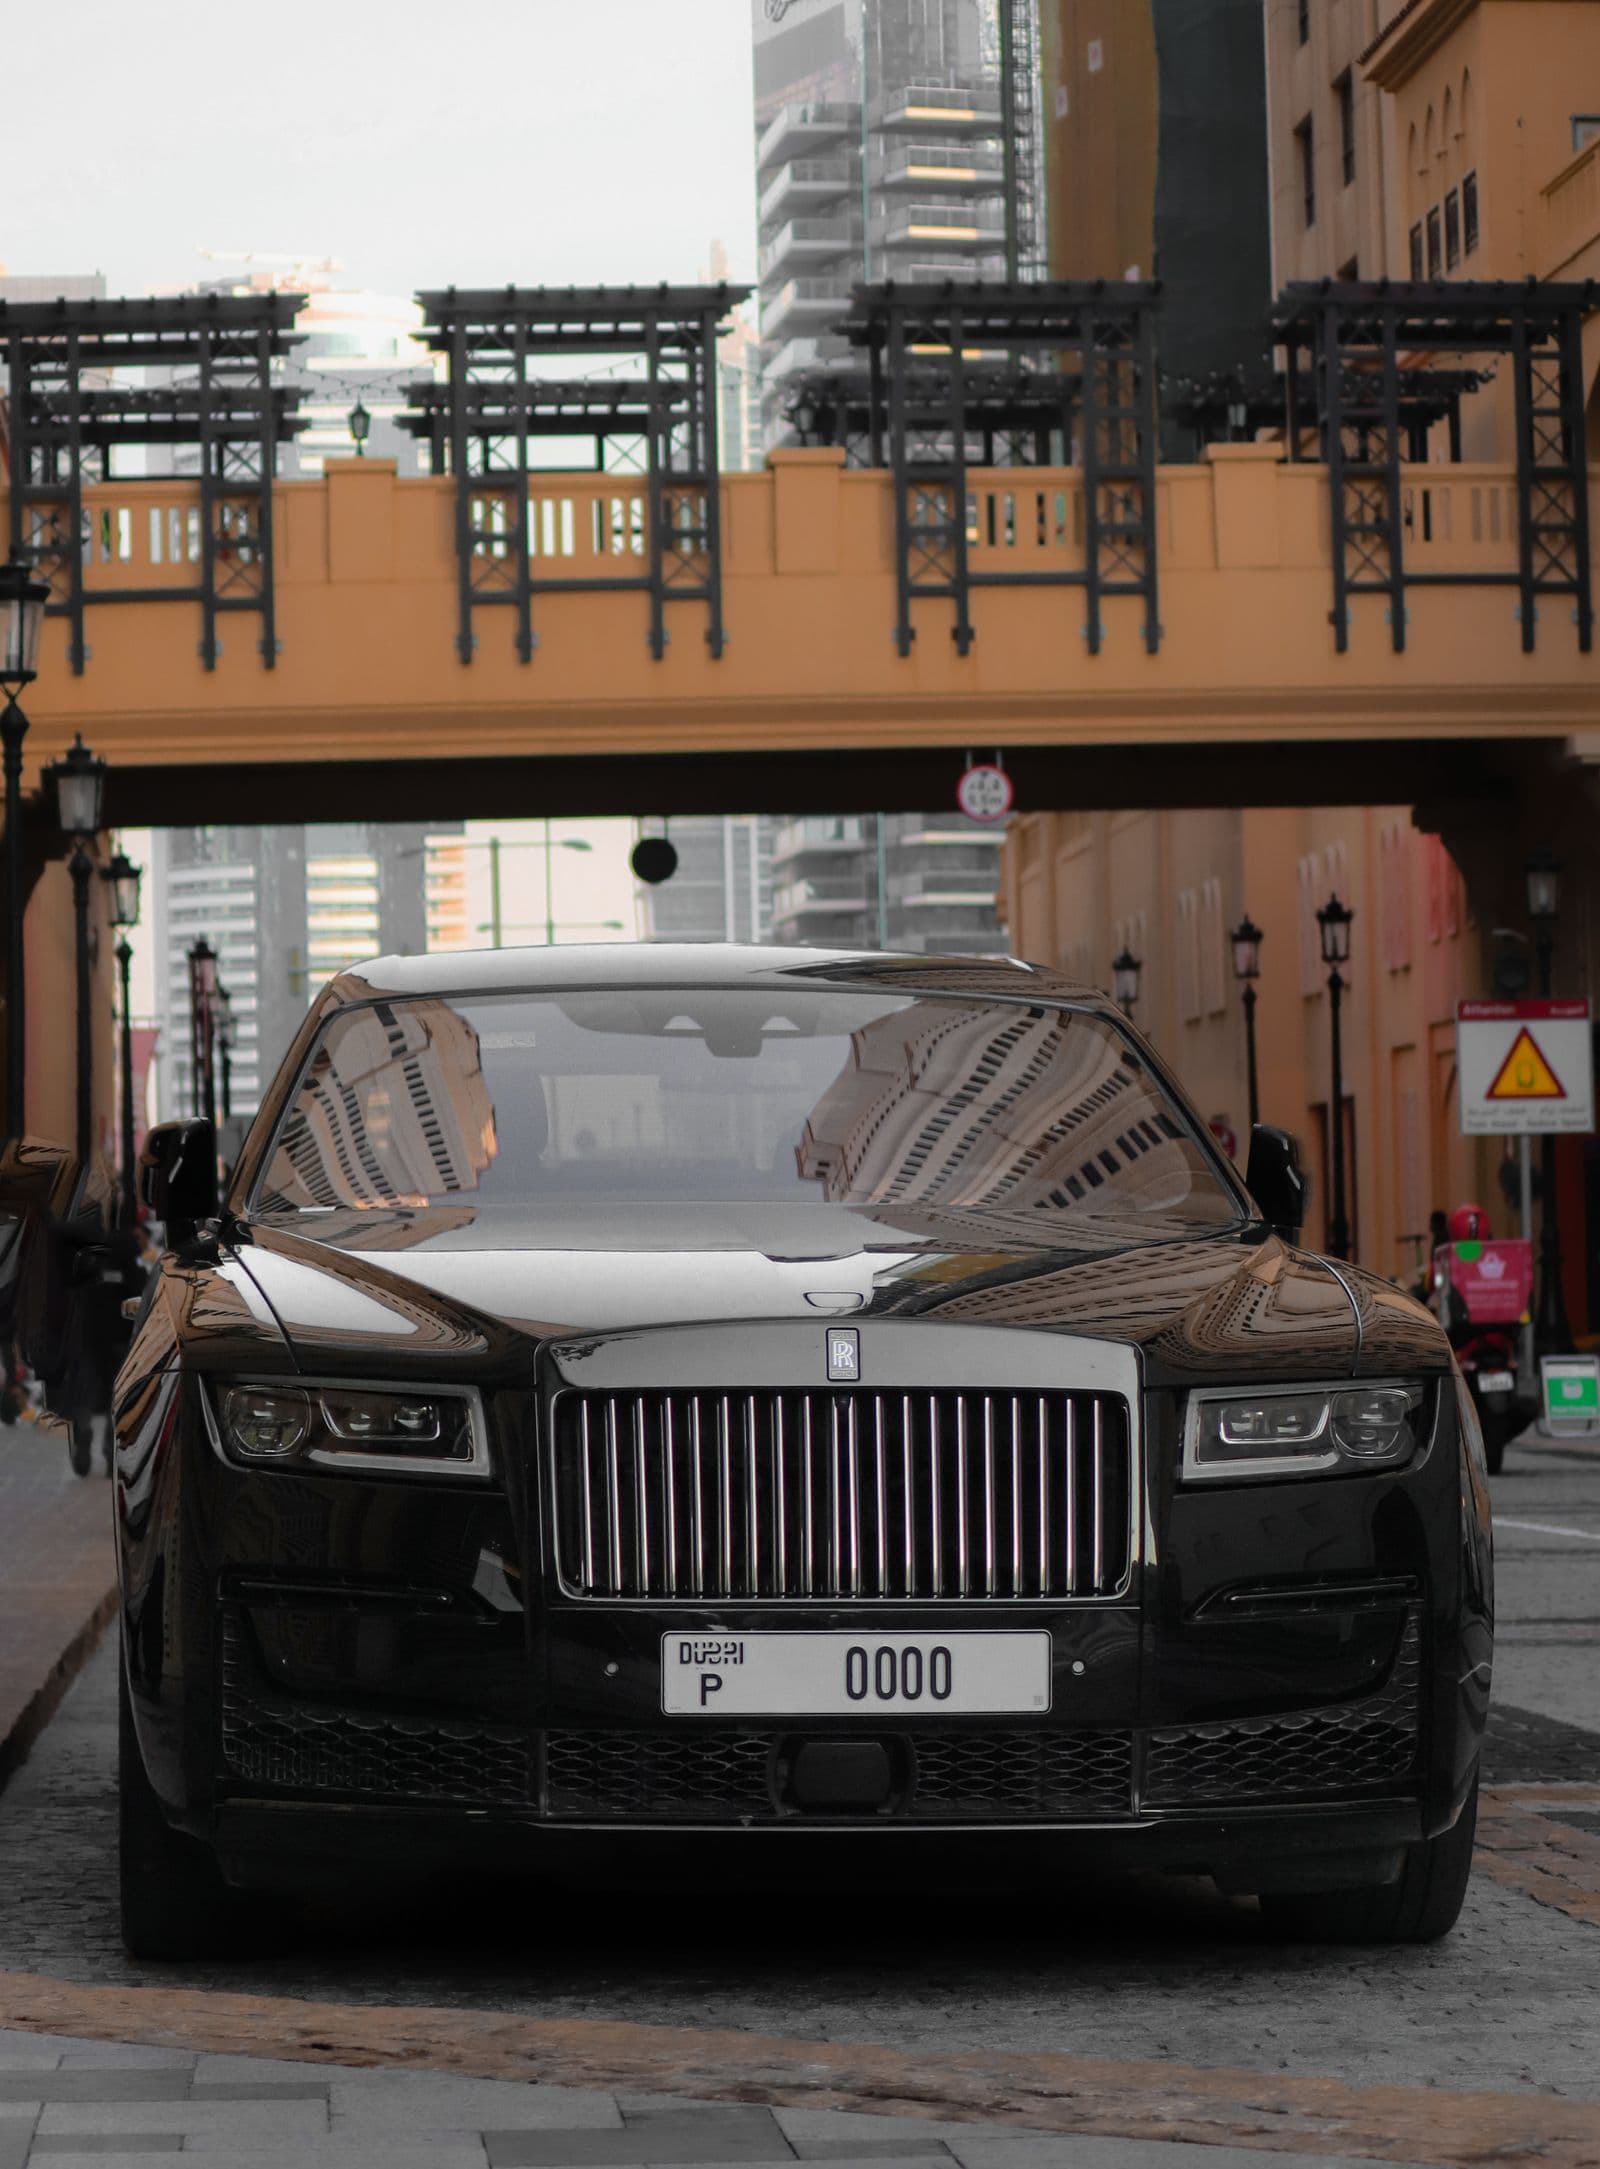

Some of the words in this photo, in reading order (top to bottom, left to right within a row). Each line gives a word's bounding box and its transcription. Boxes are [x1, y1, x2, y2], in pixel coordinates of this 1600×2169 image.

[833, 1341, 854, 1368] RR
[679, 1641, 744, 1665] DUBAI
[845, 1645, 952, 1701] 0000
[700, 1673, 723, 1706] P
